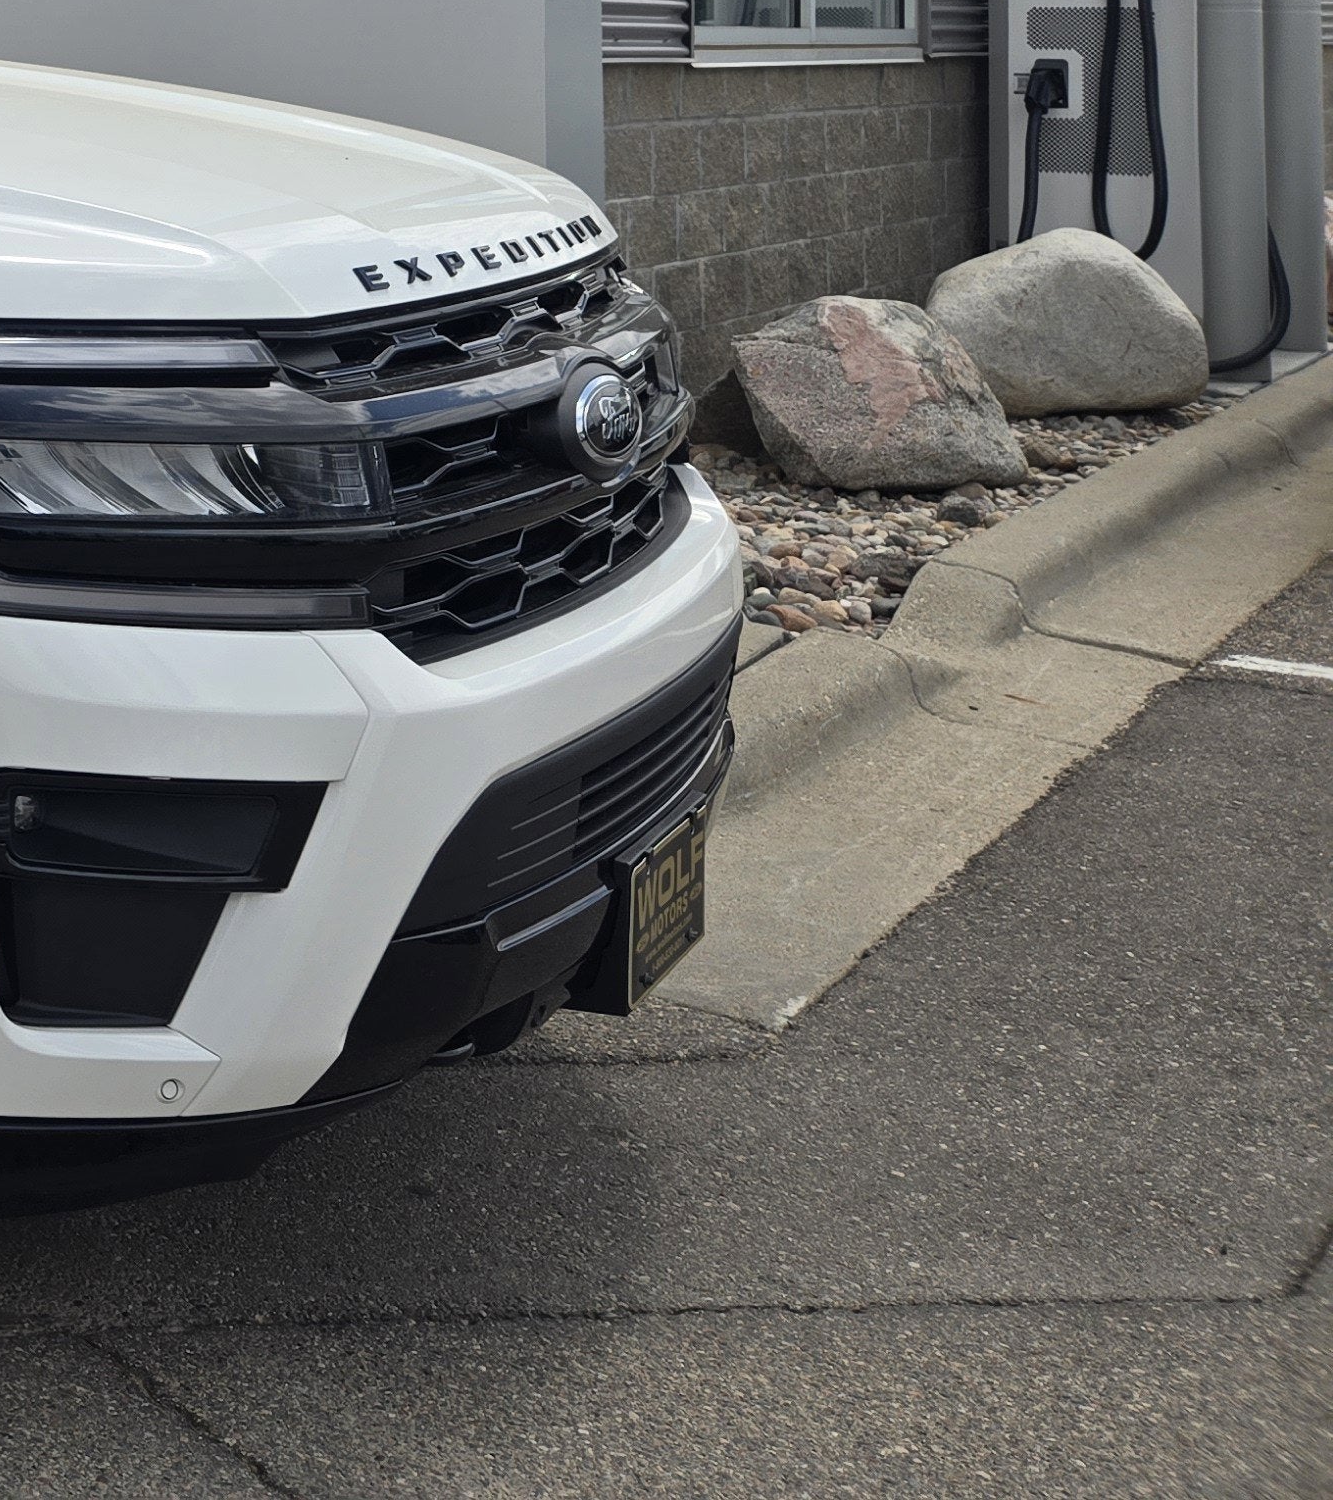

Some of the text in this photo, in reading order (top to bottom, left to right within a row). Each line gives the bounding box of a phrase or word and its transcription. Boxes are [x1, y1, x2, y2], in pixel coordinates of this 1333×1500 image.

[352, 214, 603, 293] EXPEDITION
[637, 830, 704, 932] WOLF
[650, 890, 689, 943] MOTORS
